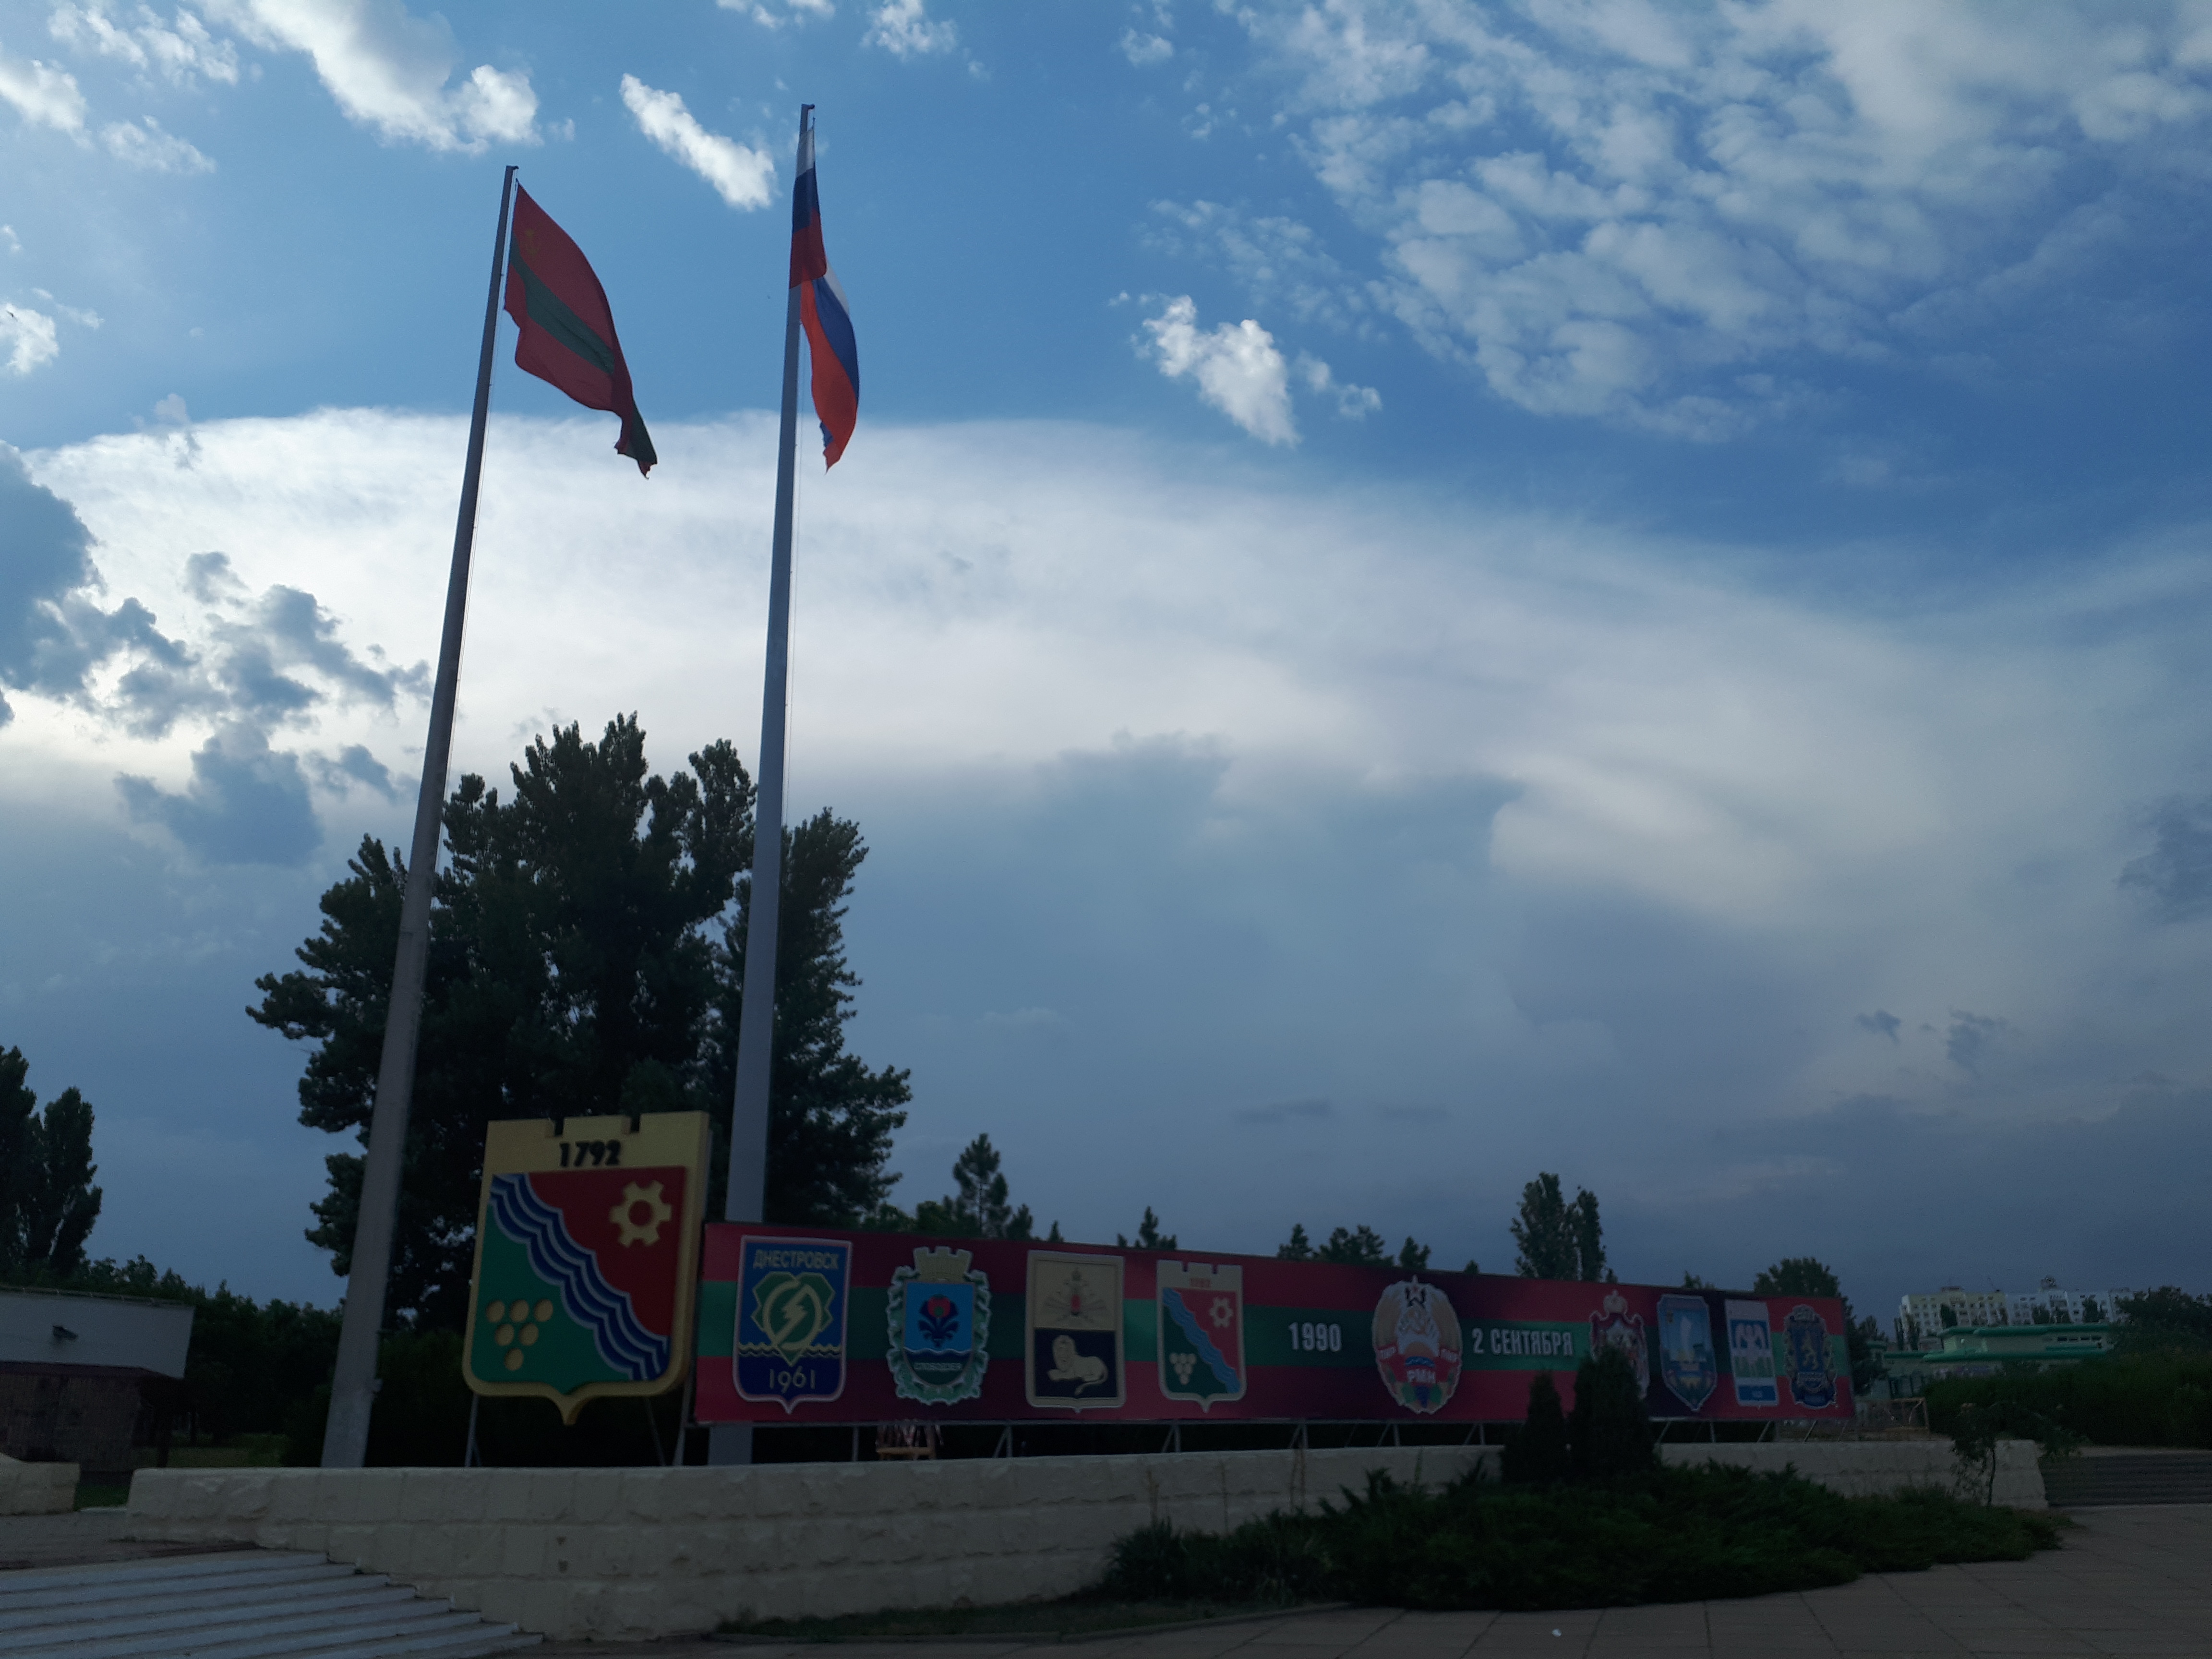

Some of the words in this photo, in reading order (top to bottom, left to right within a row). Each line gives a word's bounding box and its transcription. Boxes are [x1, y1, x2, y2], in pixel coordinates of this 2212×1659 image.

[560, 1139, 620, 1166] 1792
[753, 1249, 839, 1269] ДНЕСТРОВСК
[1288, 1322, 1342, 1352] 1990
[1472, 1327, 1484, 1354] 2
[1490, 1328, 1573, 1356] СЕНТЯБРЯ
[769, 1366, 816, 1394] 1961
